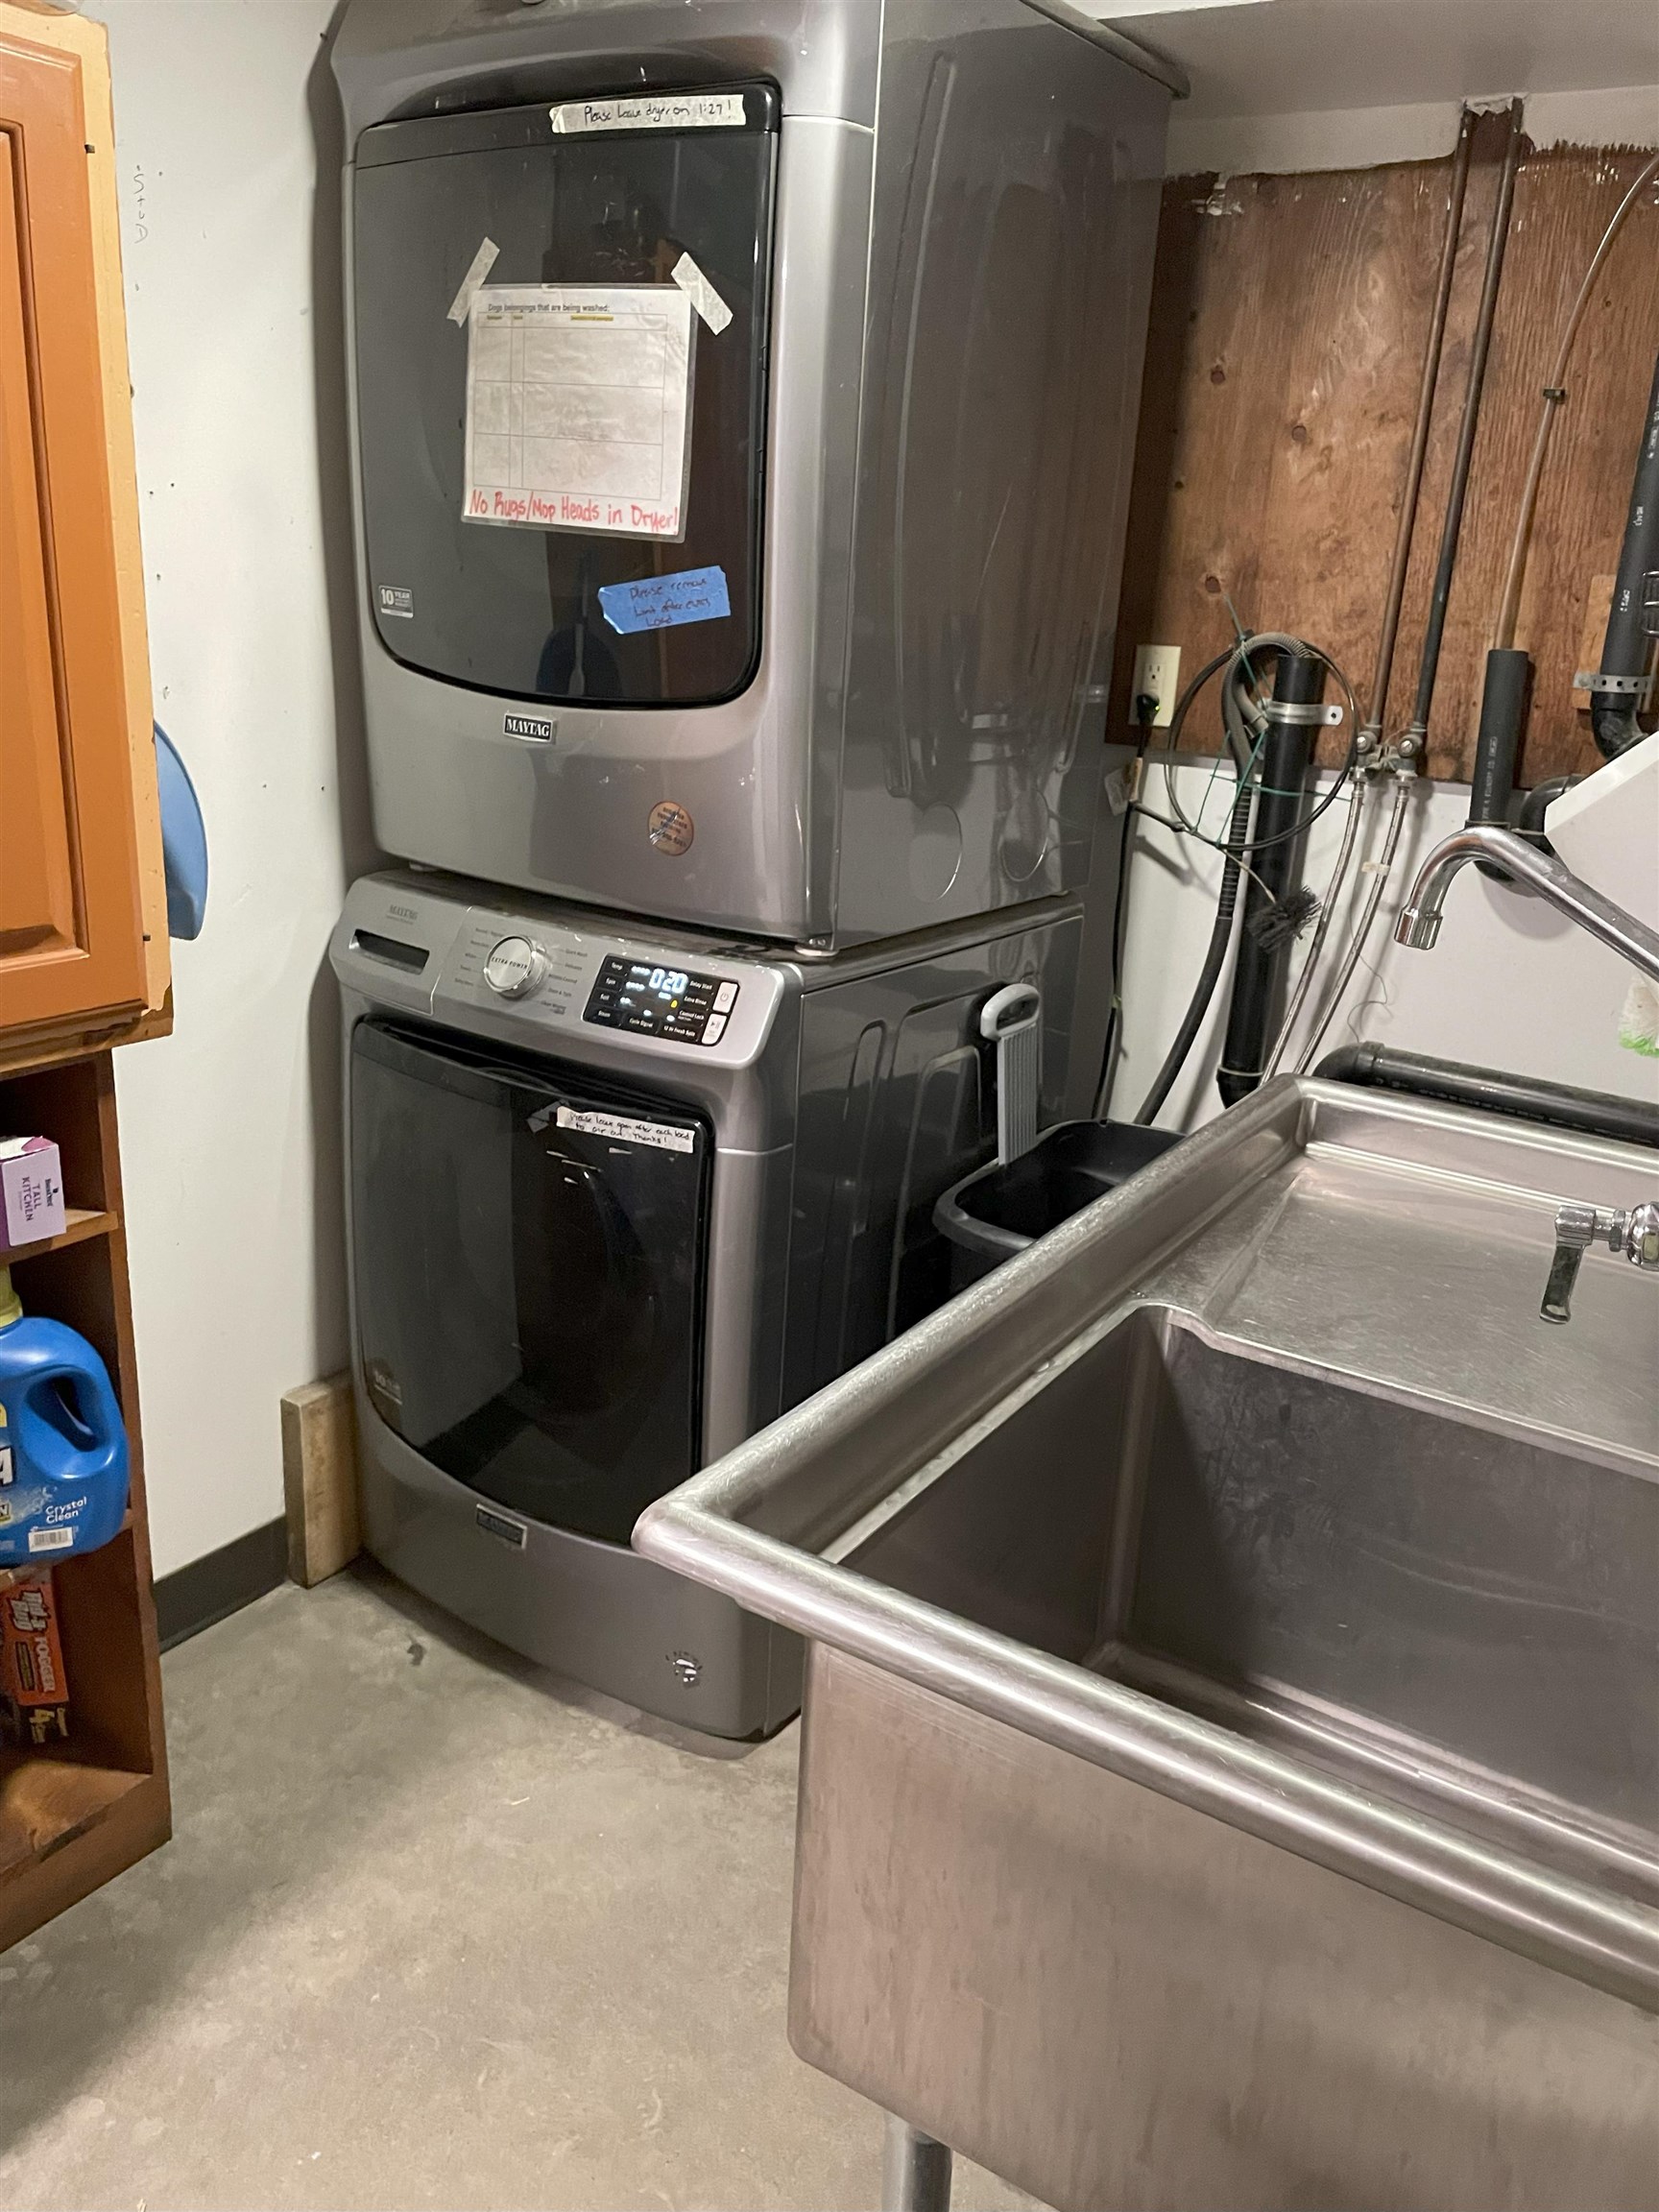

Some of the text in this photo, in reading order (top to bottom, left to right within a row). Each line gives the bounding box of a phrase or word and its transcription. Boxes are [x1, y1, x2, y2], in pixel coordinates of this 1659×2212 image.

[673, 107, 690, 115] on
[563, 303, 581, 313] being
[469, 489, 488, 515] No
[562, 495, 599, 521] Heads
[608, 504, 622, 525] in
[381, 589, 395, 605] 10
[507, 718, 550, 737] MAYTAG
[491, 956, 508, 965] EXTRA
[22, 1176, 34, 1222] KITCHEN
[32, 1183, 42, 1210] TALL
[45, 1496, 87, 1516] Crystal
[46, 1509, 79, 1525] Clean
